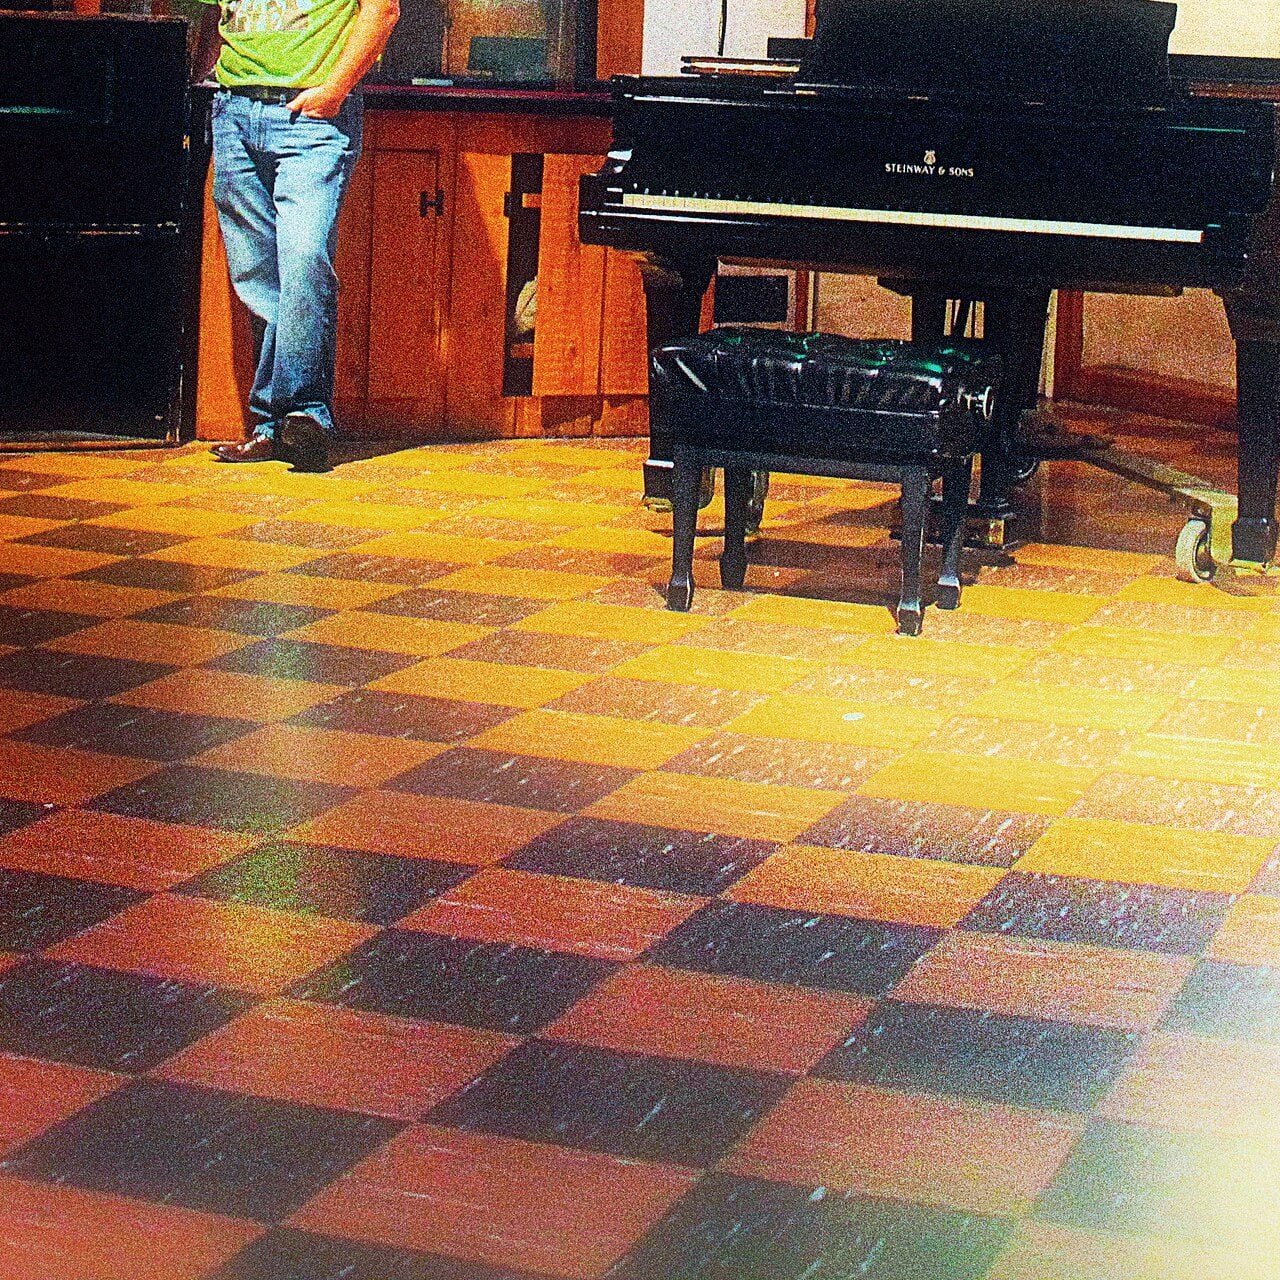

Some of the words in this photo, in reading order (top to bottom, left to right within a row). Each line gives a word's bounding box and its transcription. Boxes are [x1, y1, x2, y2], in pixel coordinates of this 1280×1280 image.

[885, 163, 935, 175] STEINWAY
[938, 166, 945, 175] &
[948, 167, 974, 177] SONS
